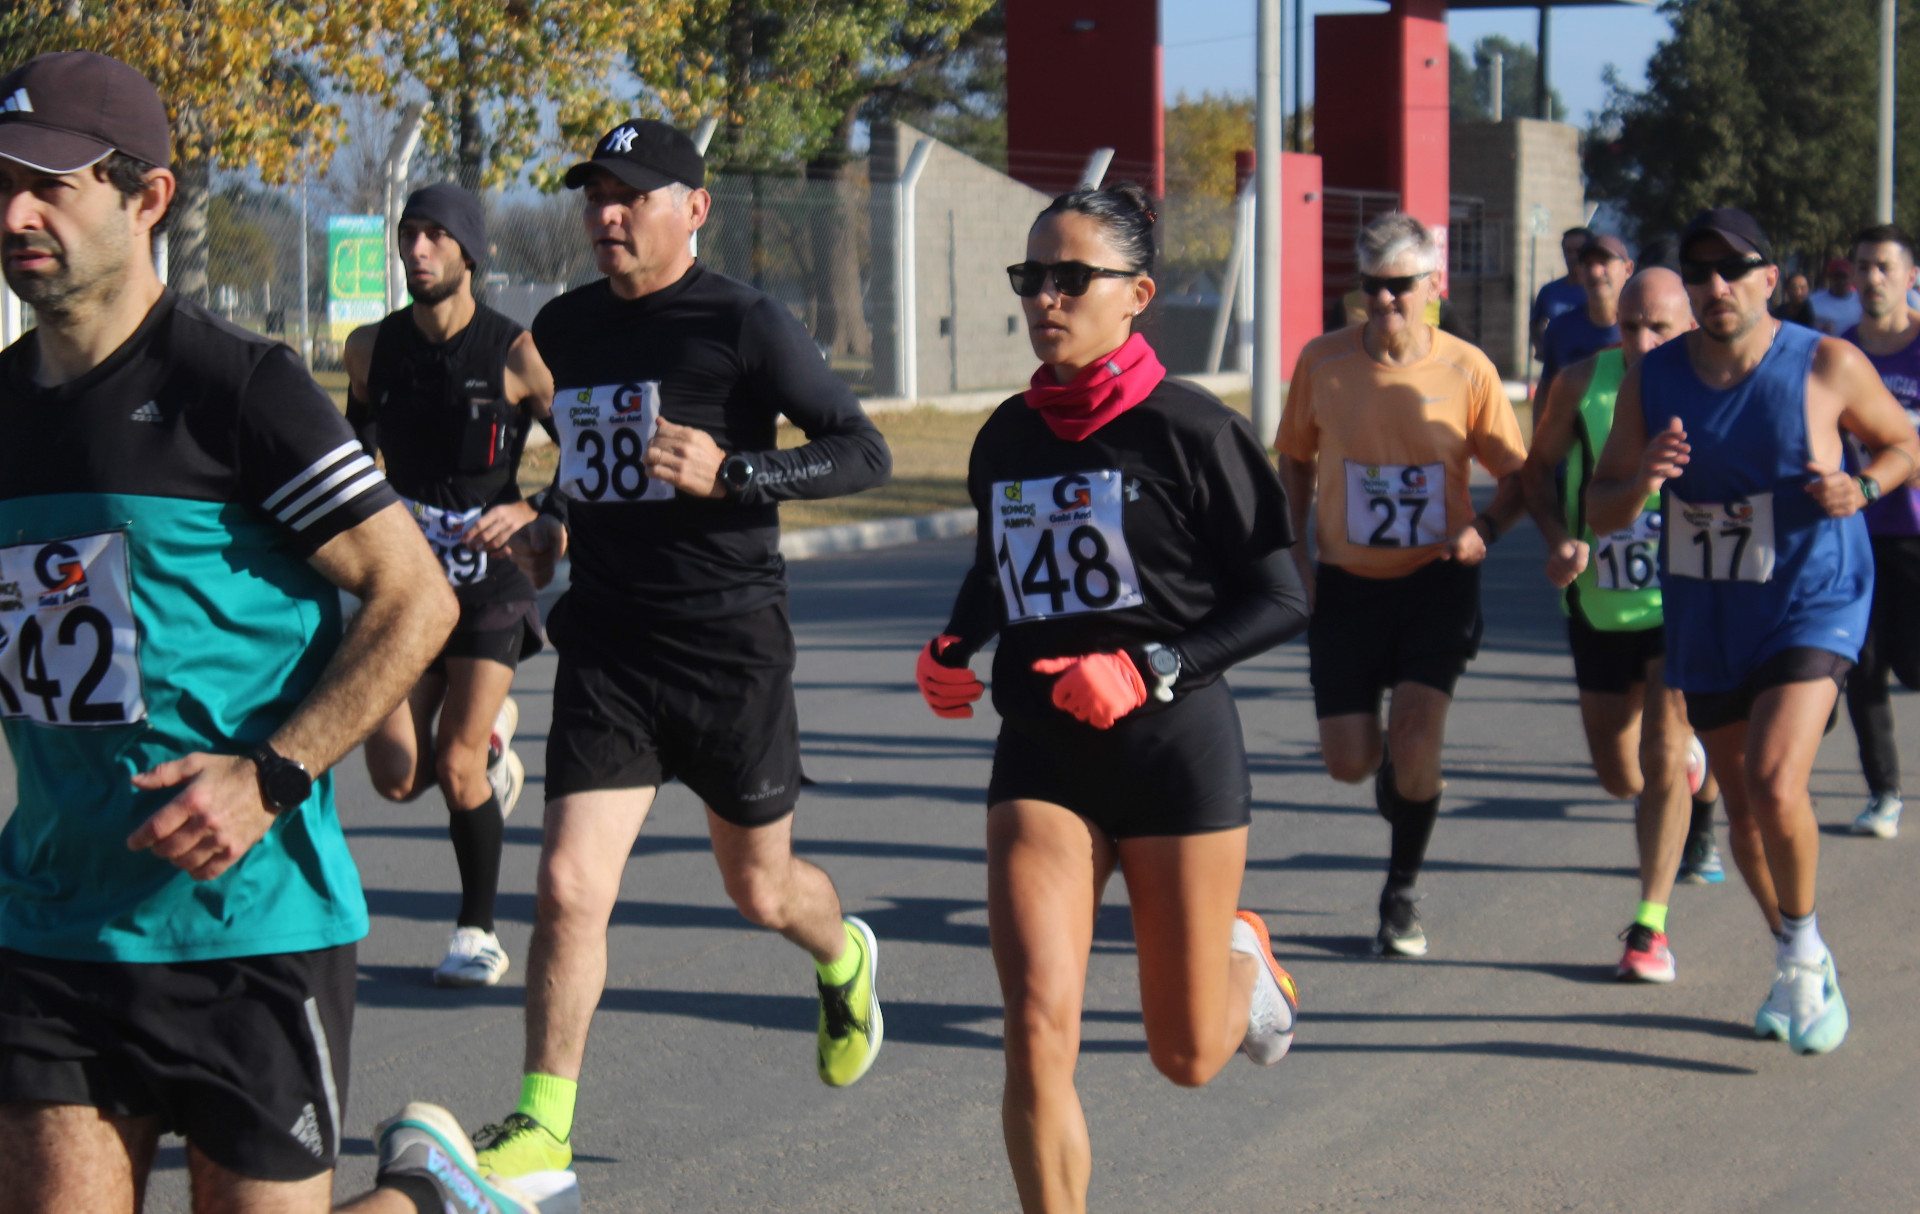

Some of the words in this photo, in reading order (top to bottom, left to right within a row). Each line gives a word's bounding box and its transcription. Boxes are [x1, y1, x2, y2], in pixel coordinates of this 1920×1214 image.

[606, 126, 639, 153] NY
[576, 427, 650, 500] 38
[1050, 512, 1072, 523] Gabi
[1369, 497, 1429, 546] 27
[999, 525, 1121, 616] 148
[1693, 527, 1752, 580] 17
